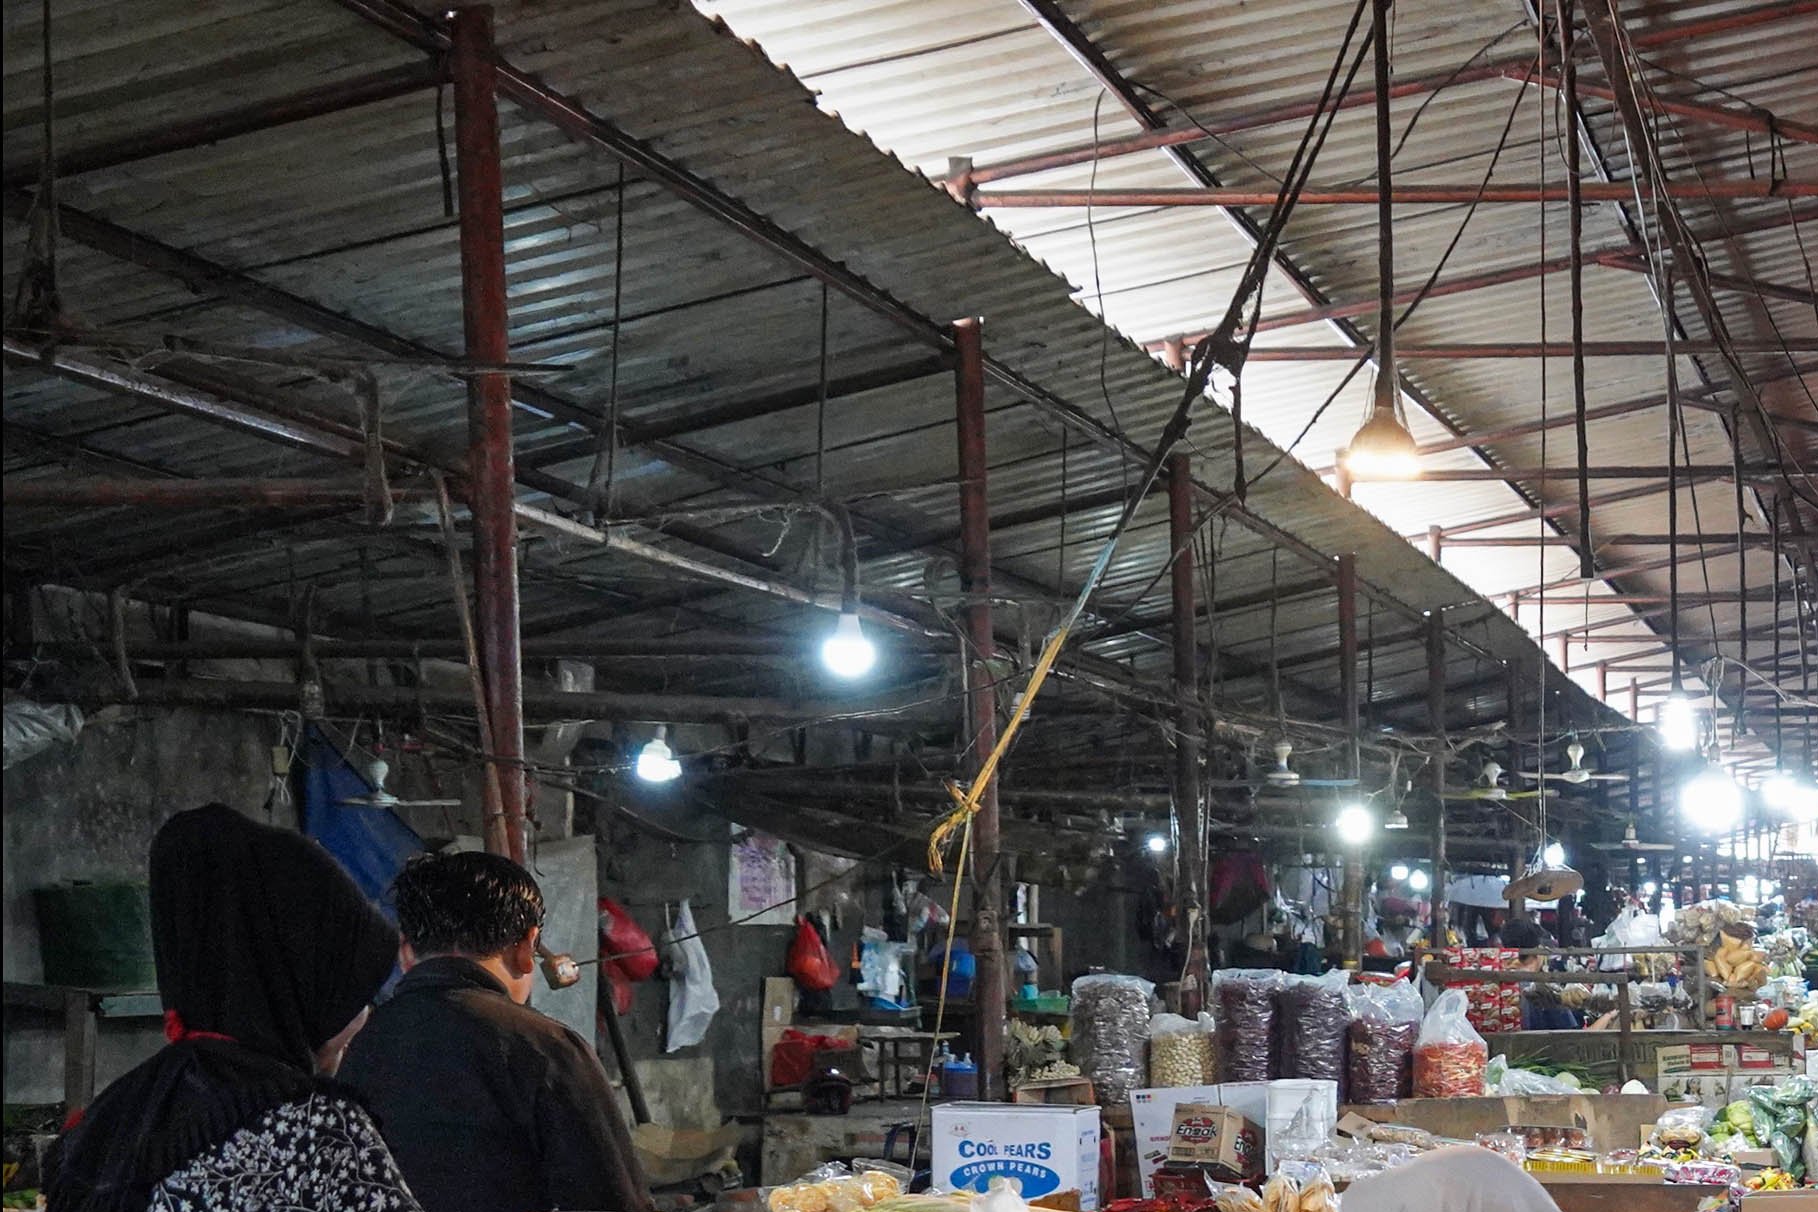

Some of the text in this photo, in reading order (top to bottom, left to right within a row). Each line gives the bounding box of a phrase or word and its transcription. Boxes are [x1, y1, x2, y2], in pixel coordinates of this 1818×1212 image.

[1004, 1142, 1052, 1160] PEARS
[963, 1162, 1047, 1179] CROWN PEARS
